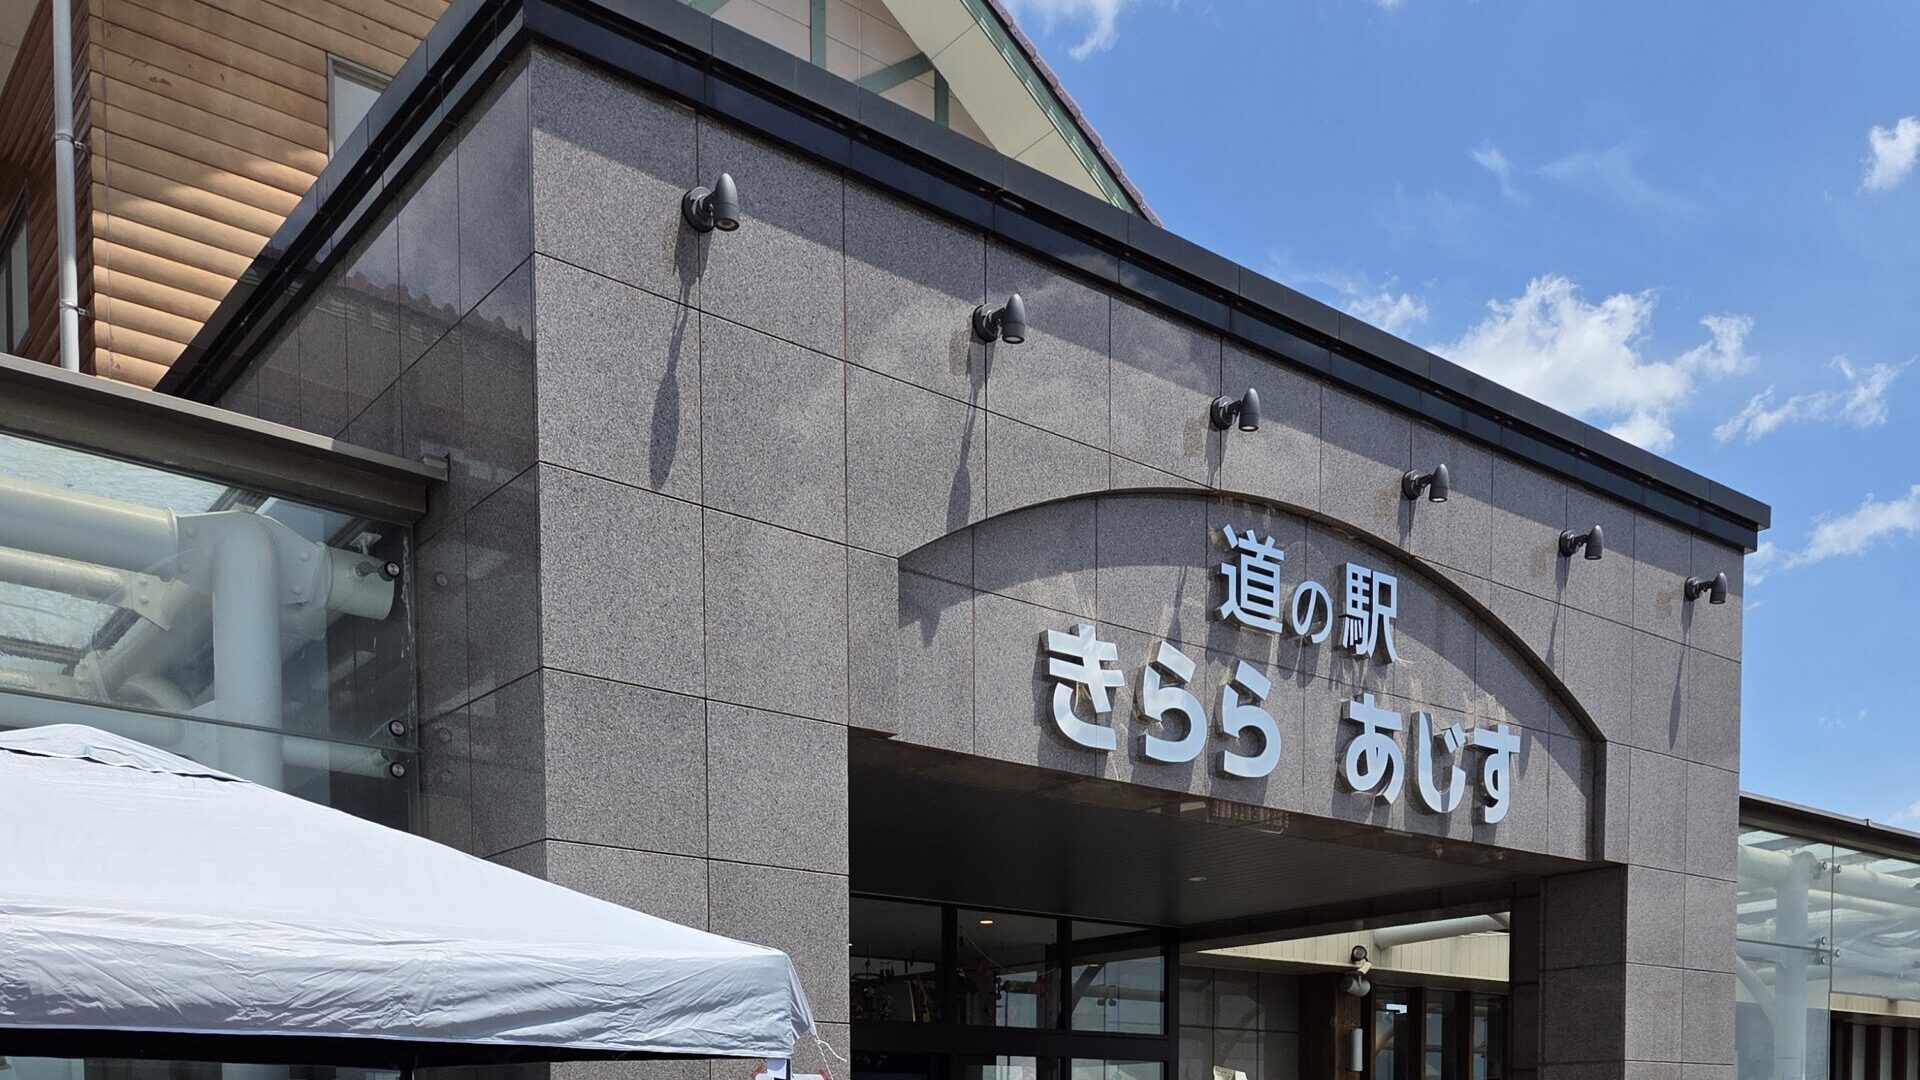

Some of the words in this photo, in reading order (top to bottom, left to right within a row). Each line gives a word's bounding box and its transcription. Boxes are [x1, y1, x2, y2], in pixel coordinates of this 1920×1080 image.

[1220, 524, 1398, 663] 道の駅
[1046, 624, 1282, 778] きらら
[1346, 693, 1521, 824] あじす
